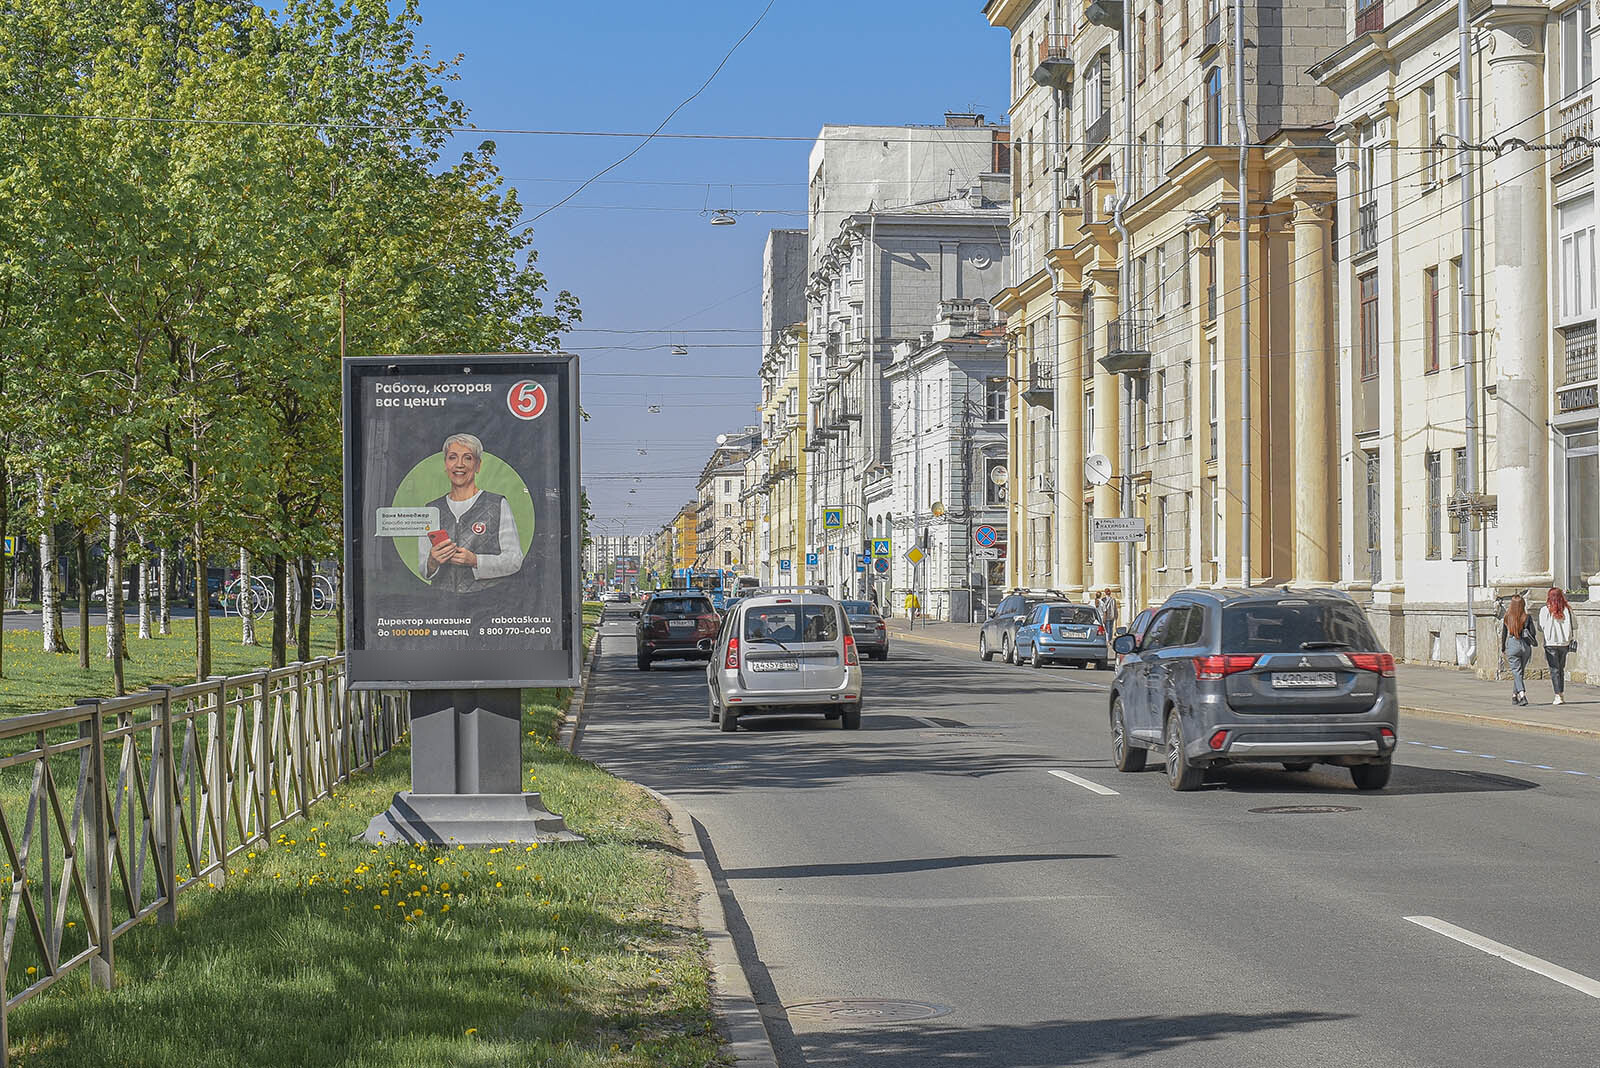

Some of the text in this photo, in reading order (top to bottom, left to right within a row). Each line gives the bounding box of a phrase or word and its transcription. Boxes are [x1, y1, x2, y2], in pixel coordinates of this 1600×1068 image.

[375, 382, 492, 395] Работа, которая
[375, 397, 447, 409] вас ценит
[377, 616, 471, 627] Директор магазина
[491, 615, 552, 625] rabota5ka.ru
[377, 628, 390, 638] до
[391, 628, 407, 637] 100
[439, 628, 470, 637] месяц
[479, 626, 552, 635] 8 800 770-04-00
